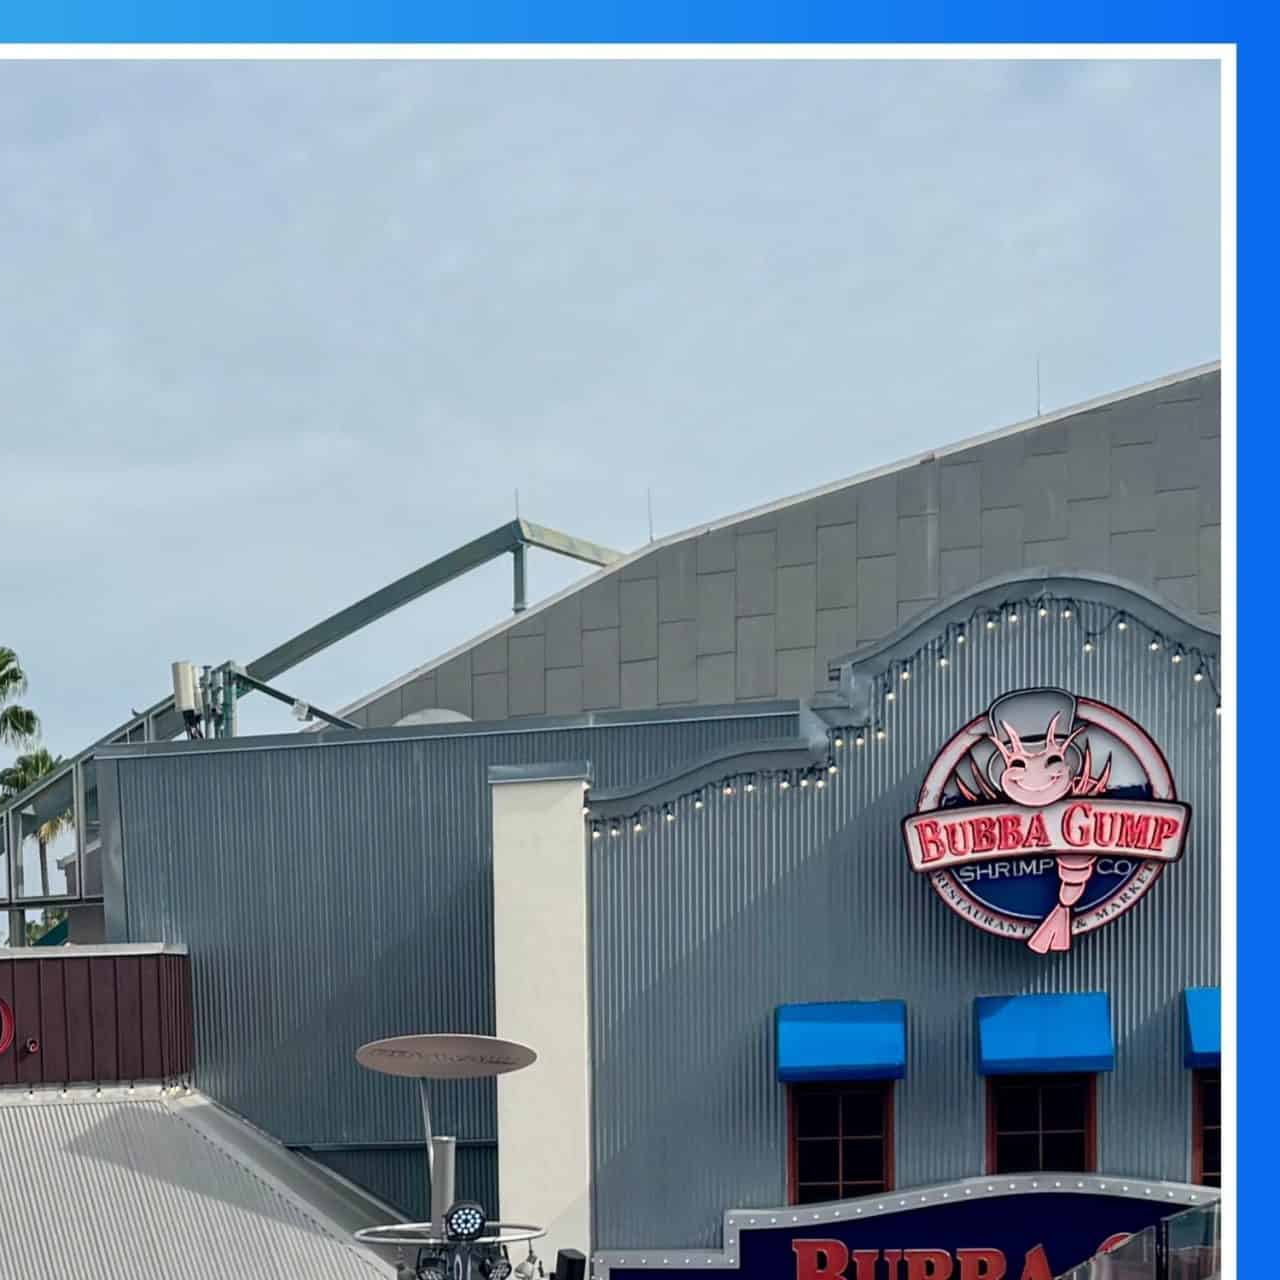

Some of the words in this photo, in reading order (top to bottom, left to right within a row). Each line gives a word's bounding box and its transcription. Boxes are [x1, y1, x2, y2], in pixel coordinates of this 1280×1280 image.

[914, 810, 1051, 865] BUBBA
[1061, 803, 1180, 852] GUMP
[934, 871, 1032, 935] RESTAURANT
[1075, 918, 1087, 930] &
[1096, 864, 1154, 921] MARKET
[959, 858, 1055, 882] SHRIMP
